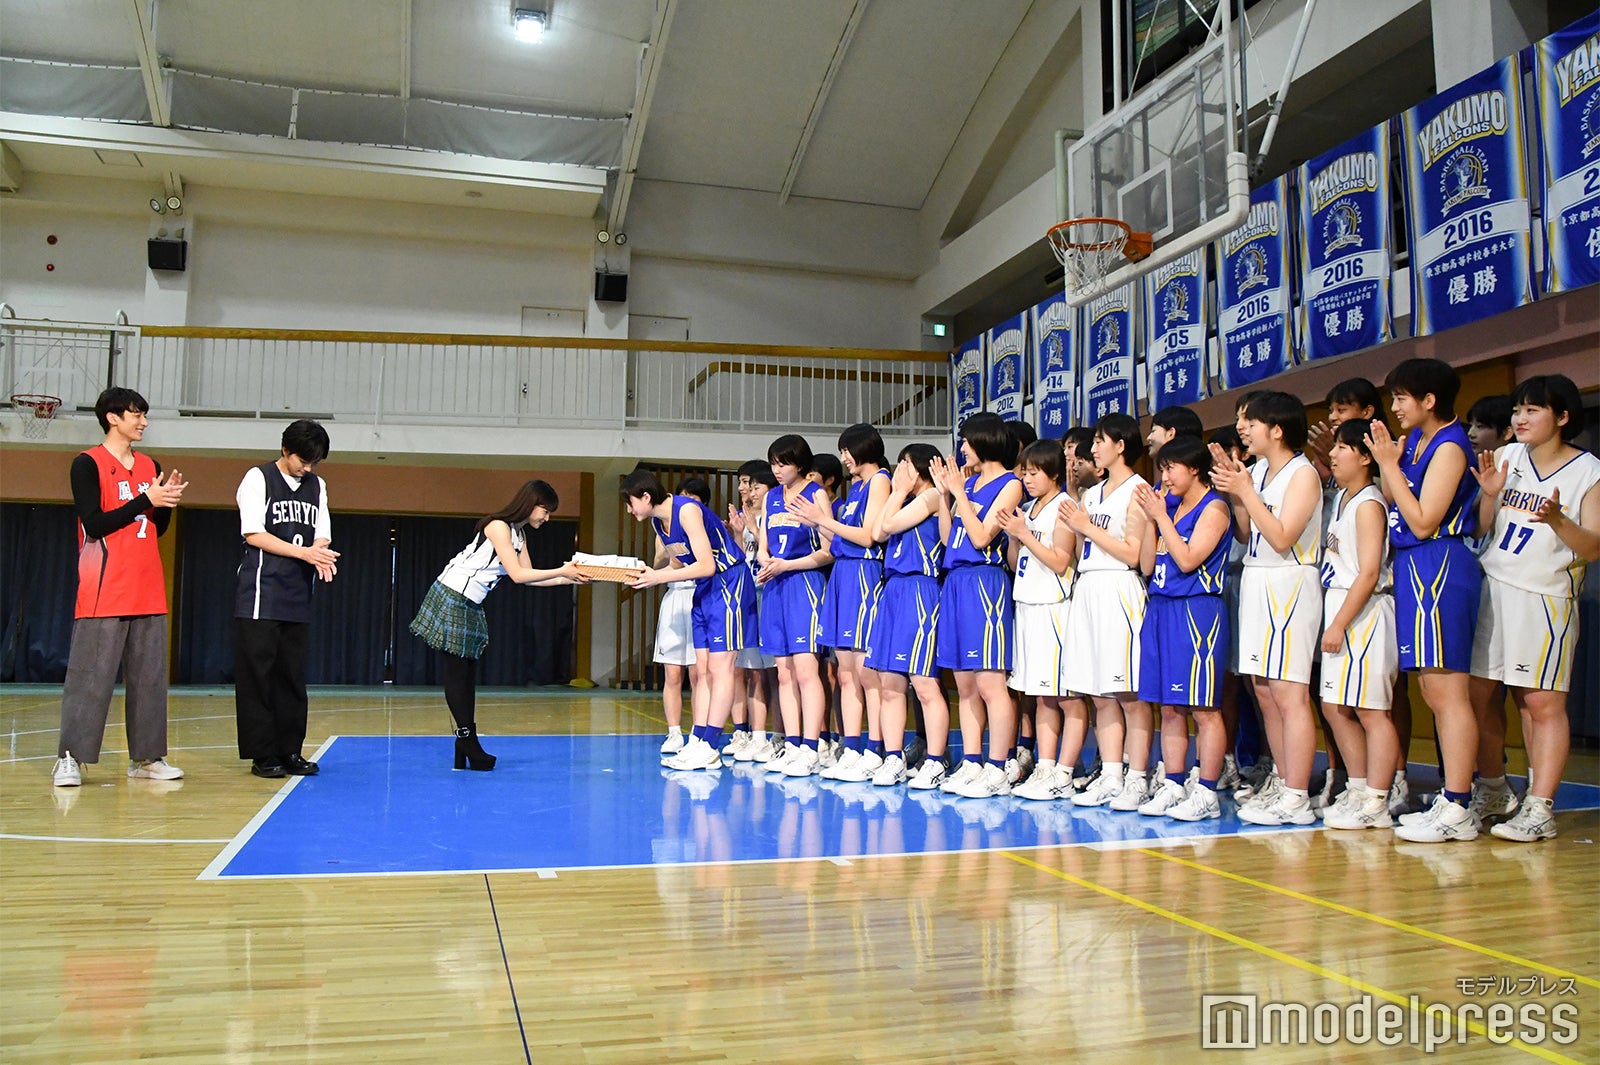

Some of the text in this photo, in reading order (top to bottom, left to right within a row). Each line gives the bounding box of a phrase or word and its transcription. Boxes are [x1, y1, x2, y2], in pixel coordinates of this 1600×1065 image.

[1419, 91, 1506, 166] YAKUMO
[1432, 121, 1490, 157] FALCONS
[1309, 153, 1377, 211] YAKUMO
[1440, 145, 1489, 193] BASKETBALL TEAM
[1320, 178, 1365, 204] FALCONS
[1443, 210, 1494, 250] 2016
[1323, 257, 1363, 288] 2016
[1446, 265, 1498, 305] 優勝
[1237, 295, 1270, 323] 2016
[1324, 305, 1364, 337] 優勝
[1238, 338, 1271, 368] 優勝
[1096, 361, 1120, 382] 2014
[997, 396, 1014, 412] 2012
[135, 514, 148, 539] 7
[273, 500, 319, 528] SEIRYO
[778, 534, 788, 555] 7
[1499, 522, 1534, 555] 17
